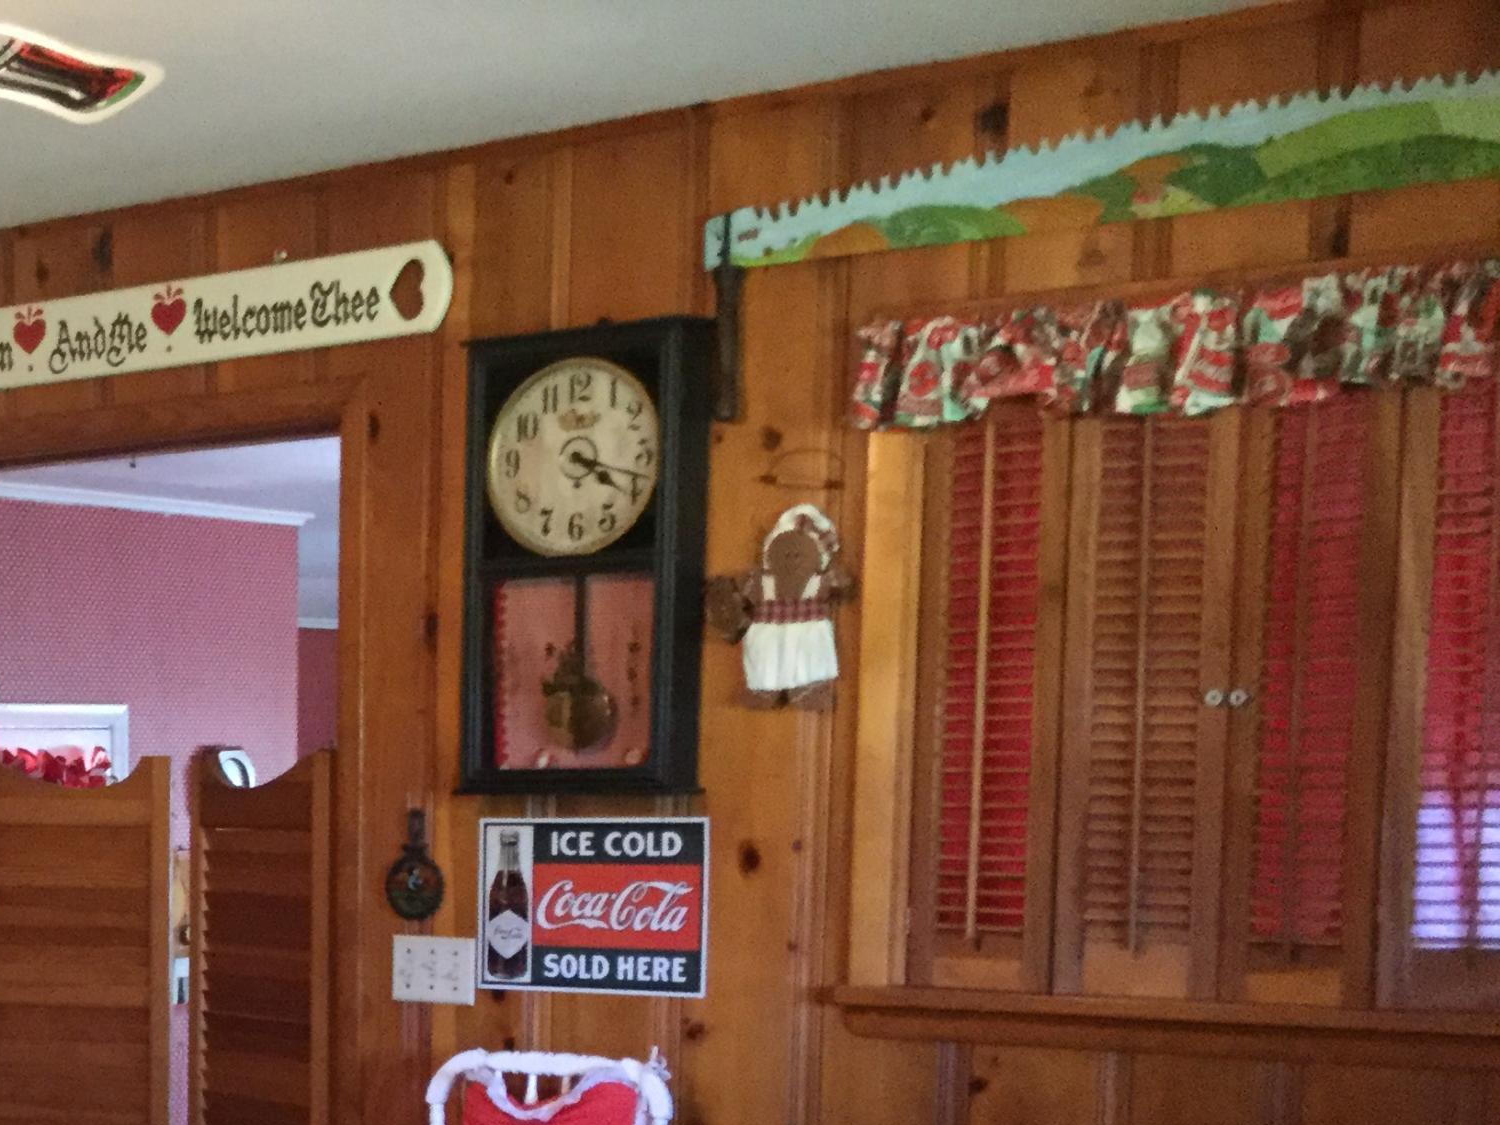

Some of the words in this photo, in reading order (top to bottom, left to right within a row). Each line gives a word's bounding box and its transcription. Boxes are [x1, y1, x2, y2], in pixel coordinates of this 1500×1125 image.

[49, 316, 107, 374] And
[105, 311, 147, 367] Me
[193, 294, 307, 343] Welcome
[308, 279, 381, 327] Thee
[542, 384, 558, 414] 11
[569, 373, 592, 404] 12
[609, 378, 618, 408] 1
[516, 413, 539, 443] 10
[627, 402, 642, 431] 2
[505, 449, 520, 478] 9
[540, 506, 553, 537] 7
[567, 512, 584, 541] 6
[551, 831, 595, 857] ICE
[604, 831, 683, 857] COLD
[536, 880, 693, 932] Coca-Cola
[544, 954, 610, 980] SOLD
[617, 955, 687, 983] HERE
